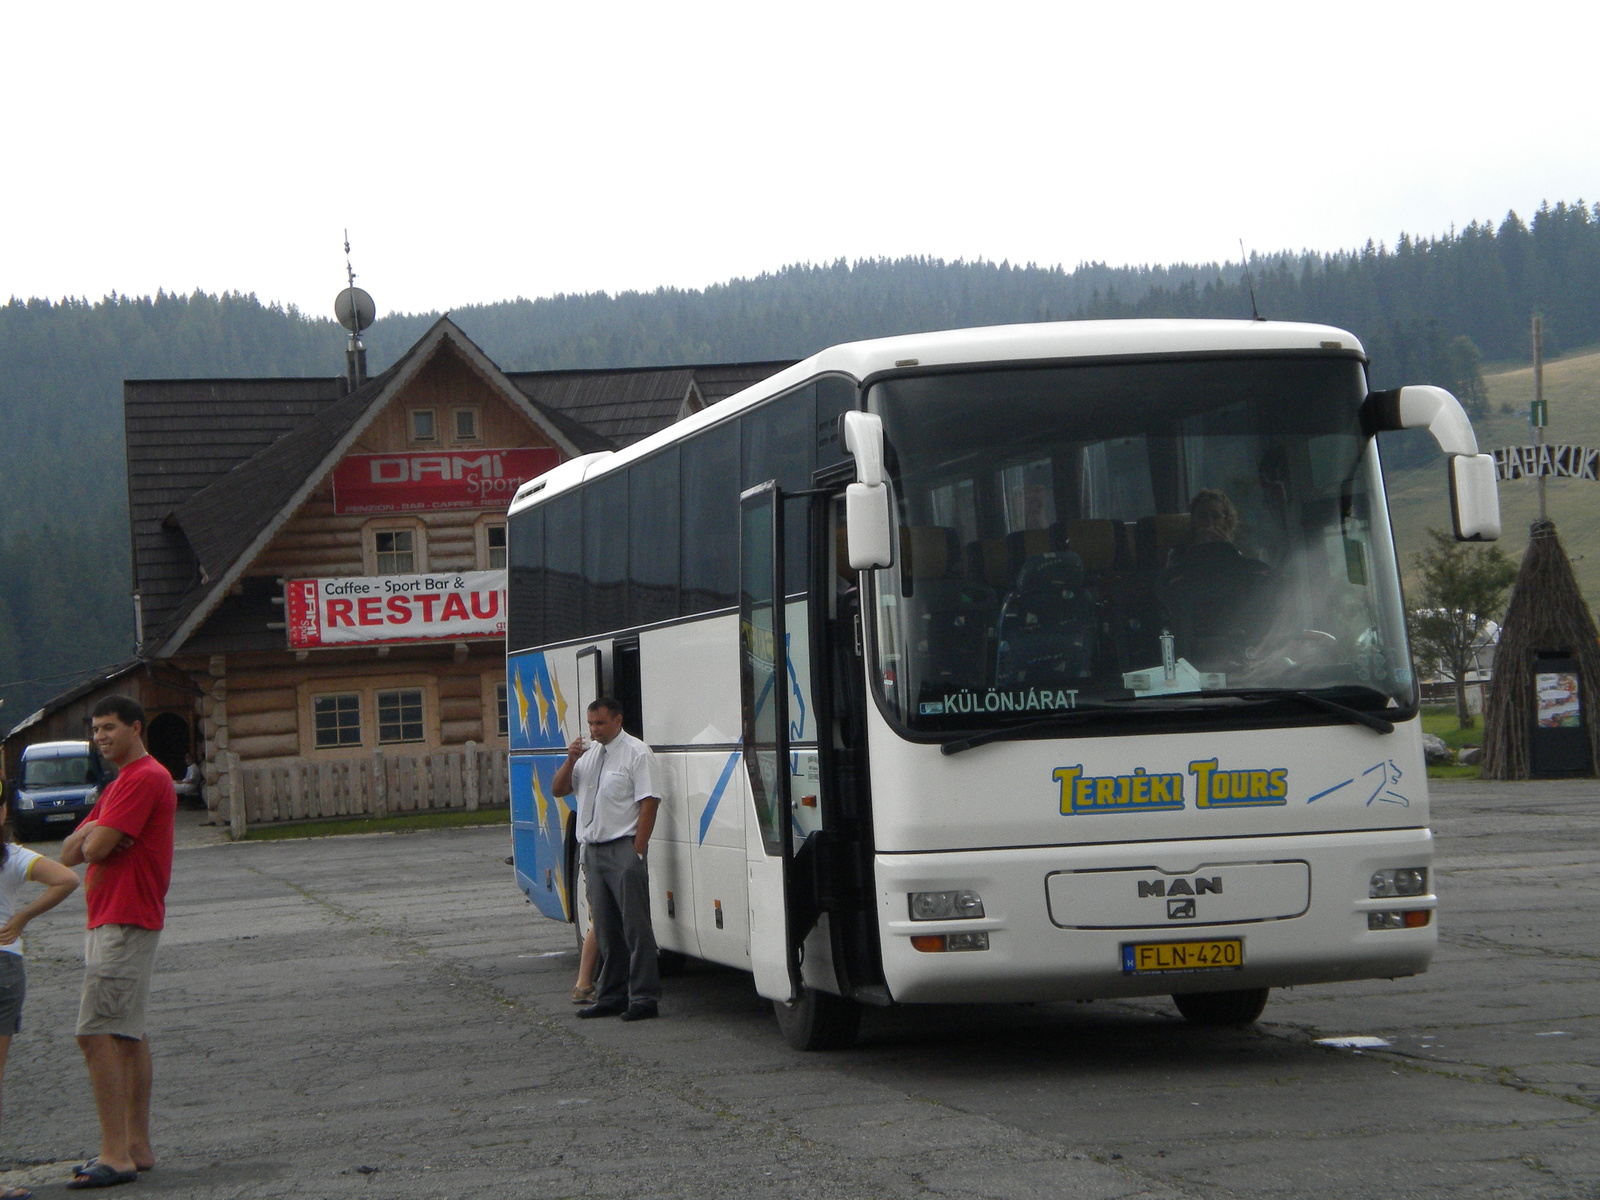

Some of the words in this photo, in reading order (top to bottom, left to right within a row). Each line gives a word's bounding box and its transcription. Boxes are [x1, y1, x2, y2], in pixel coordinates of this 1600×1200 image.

[370, 455, 503, 484] DAMI
[1491, 444, 1600, 481] HABAKUK
[466, 472, 525, 498] Sport
[345, 504, 395, 513] PENZION
[401, 501, 425, 510] BAR
[432, 500, 473, 508] CAFFEE
[325, 582, 370, 595] Caffee
[385, 579, 421, 594] Sport
[425, 578, 449, 590] Bar
[453, 577, 465, 588] &
[304, 583, 318, 636] DAMI
[326, 590, 506, 628] RESTAU
[298, 620, 309, 643] Sport
[944, 687, 1079, 714] KÜLÖNJÁRAT
[1189, 758, 1288, 809] TOURS
[1138, 877, 1223, 898] MAN
[1140, 944, 1235, 967] FLN-420
